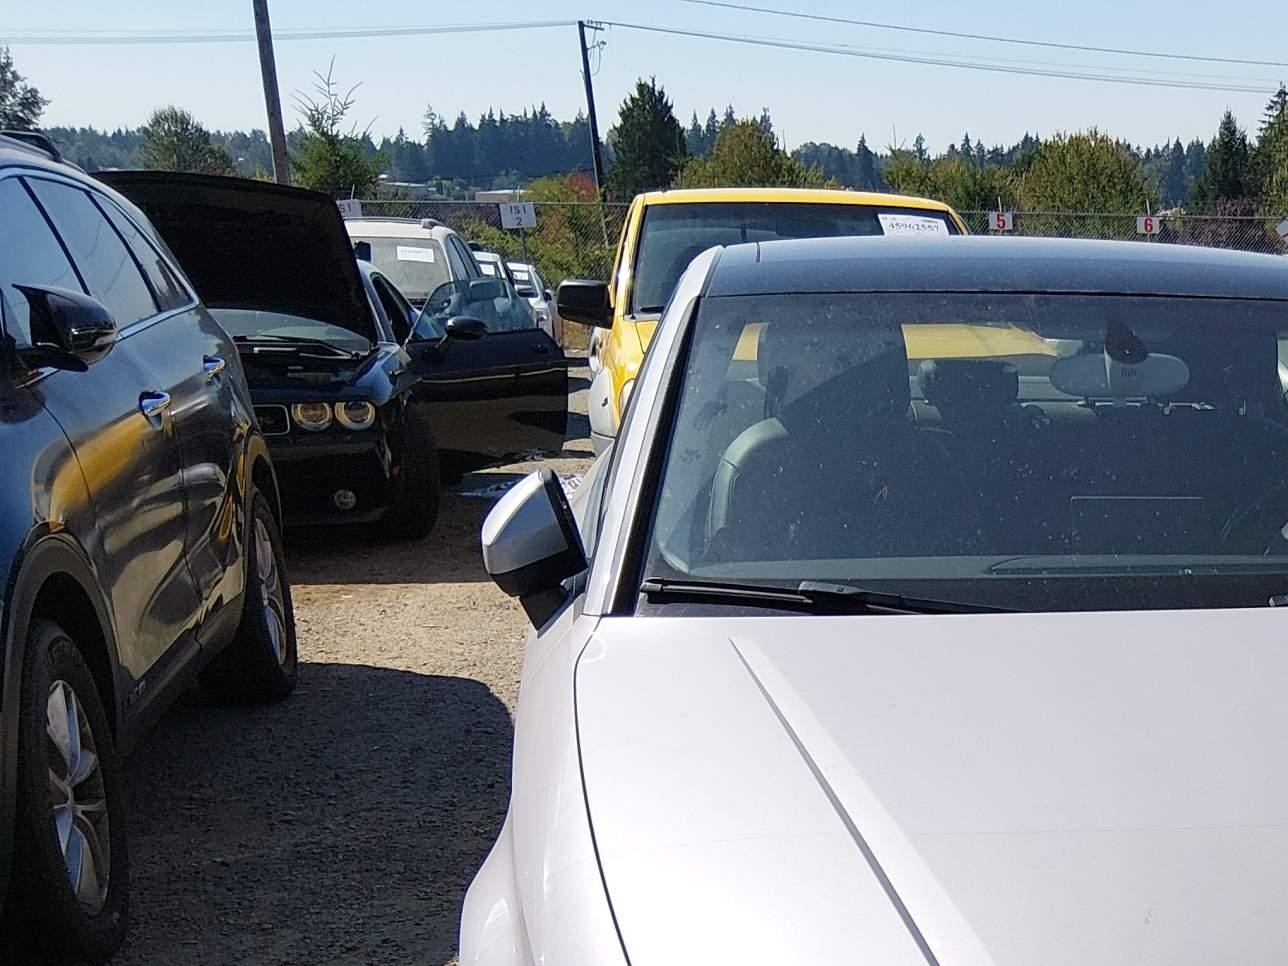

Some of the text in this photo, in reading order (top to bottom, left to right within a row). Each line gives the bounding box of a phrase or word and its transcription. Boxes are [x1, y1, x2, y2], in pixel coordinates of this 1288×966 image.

[515, 216, 522, 226] 2
[996, 213, 1006, 229] 5
[1144, 217, 1153, 233] 6
